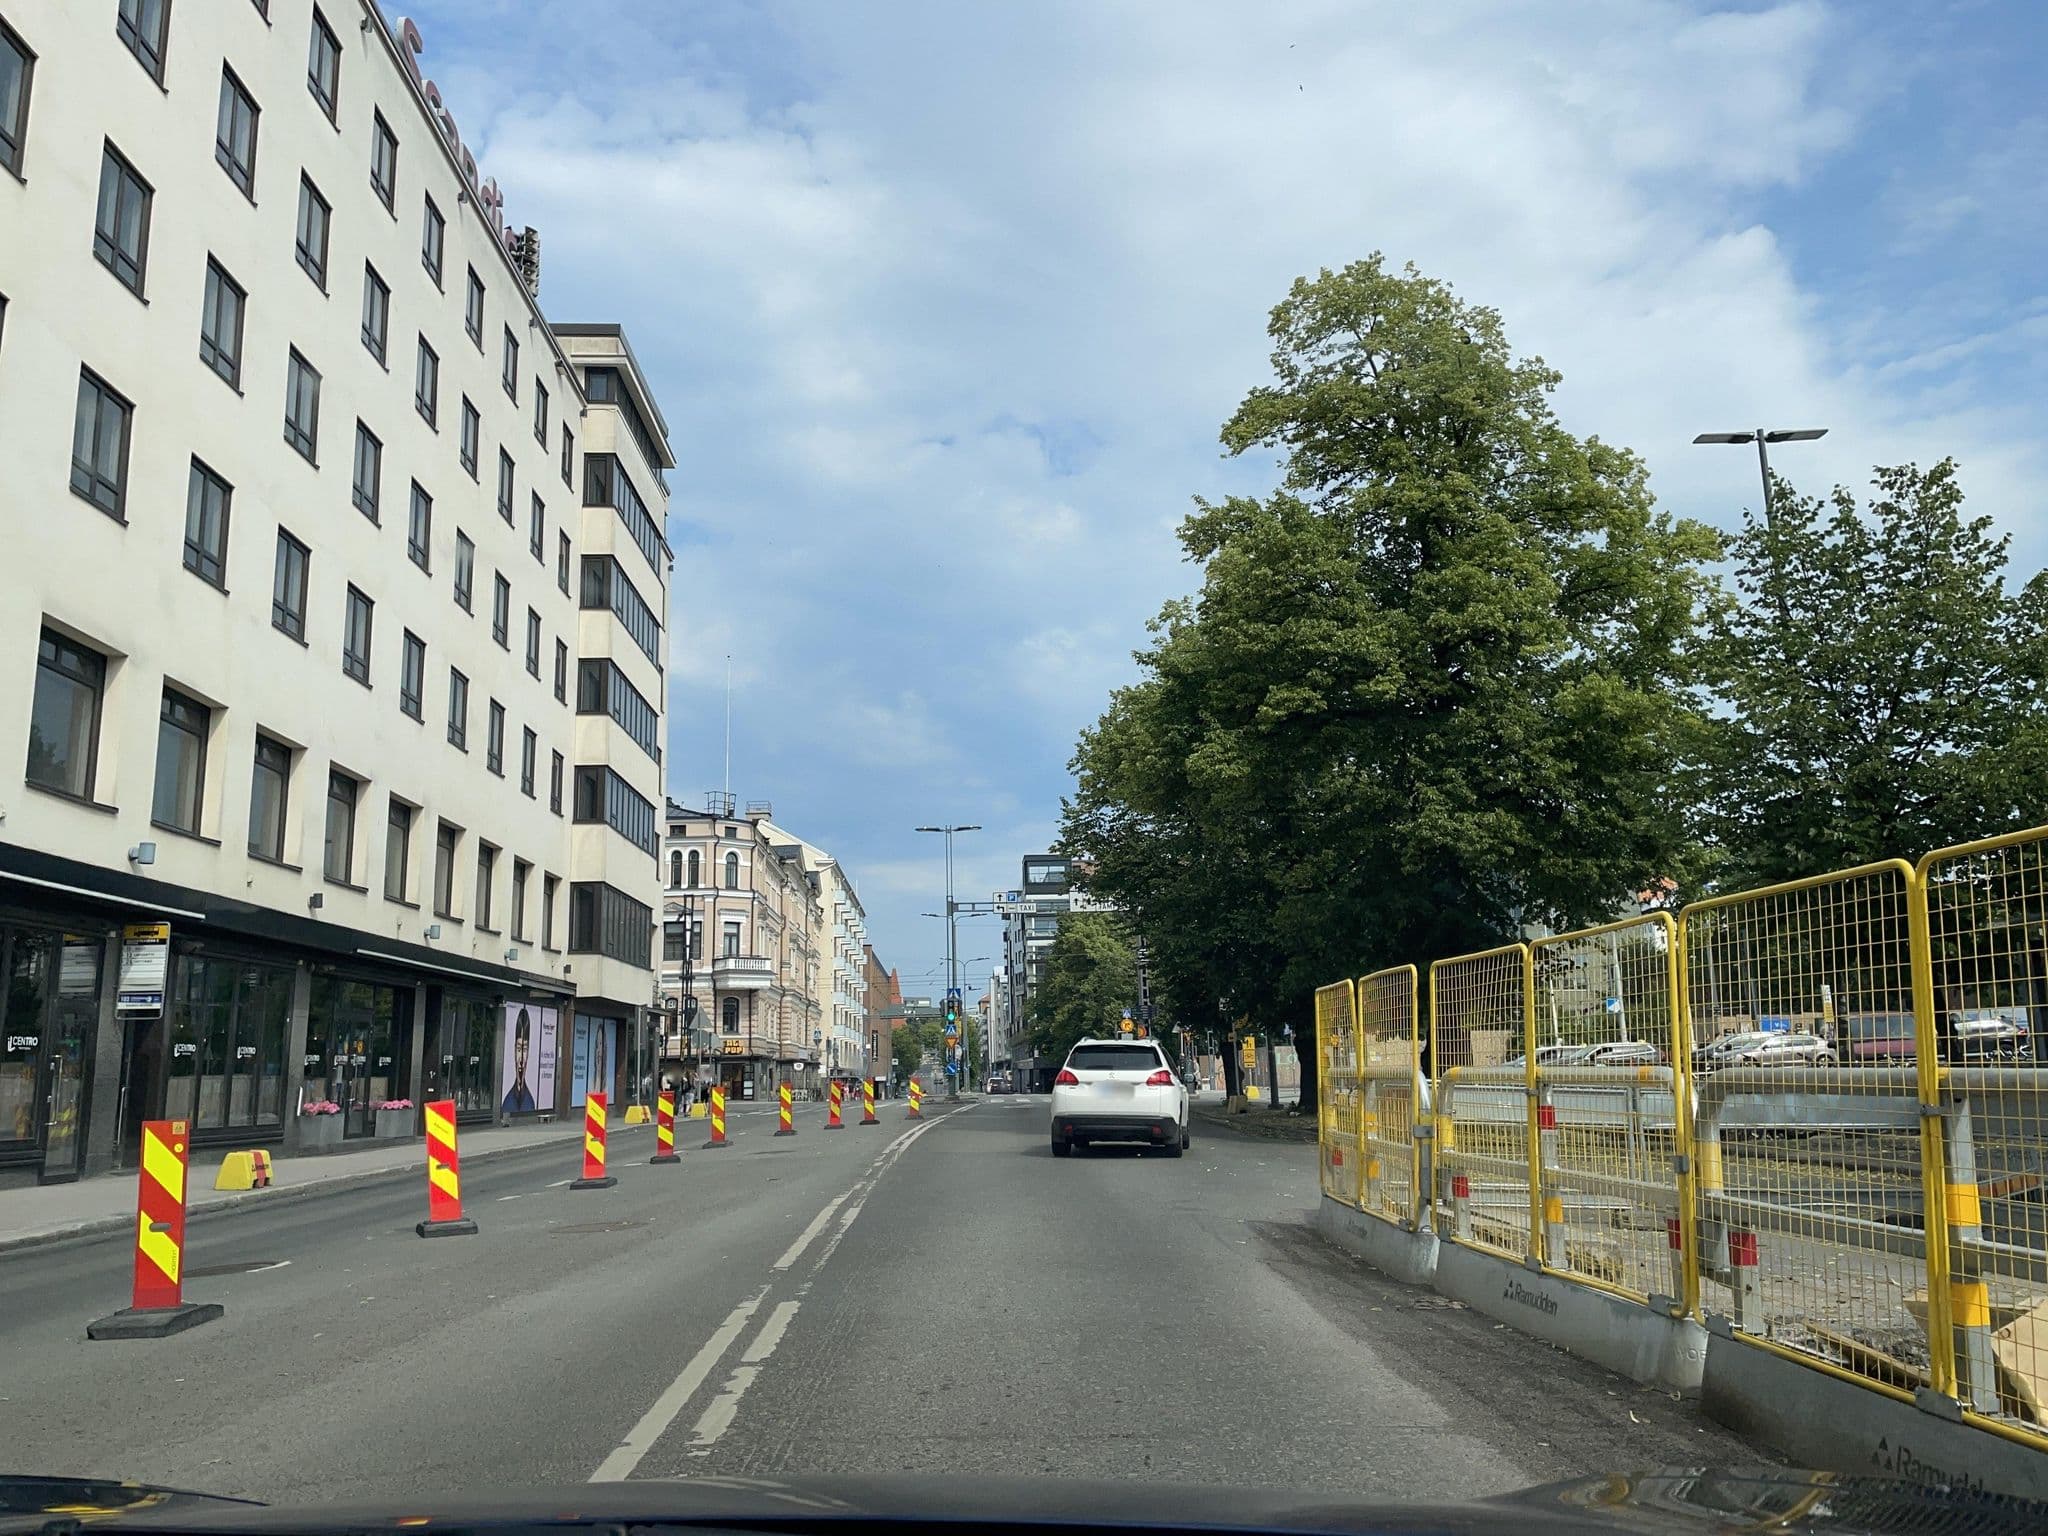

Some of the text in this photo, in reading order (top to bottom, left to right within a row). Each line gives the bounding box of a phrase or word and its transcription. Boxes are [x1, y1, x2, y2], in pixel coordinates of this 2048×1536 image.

[13, 1036, 38, 1046] CENTRO
[178, 1044, 196, 1052] CENTRO
[241, 1047, 256, 1055] CENTRO
[1513, 1282, 1558, 1317] Ramudden
